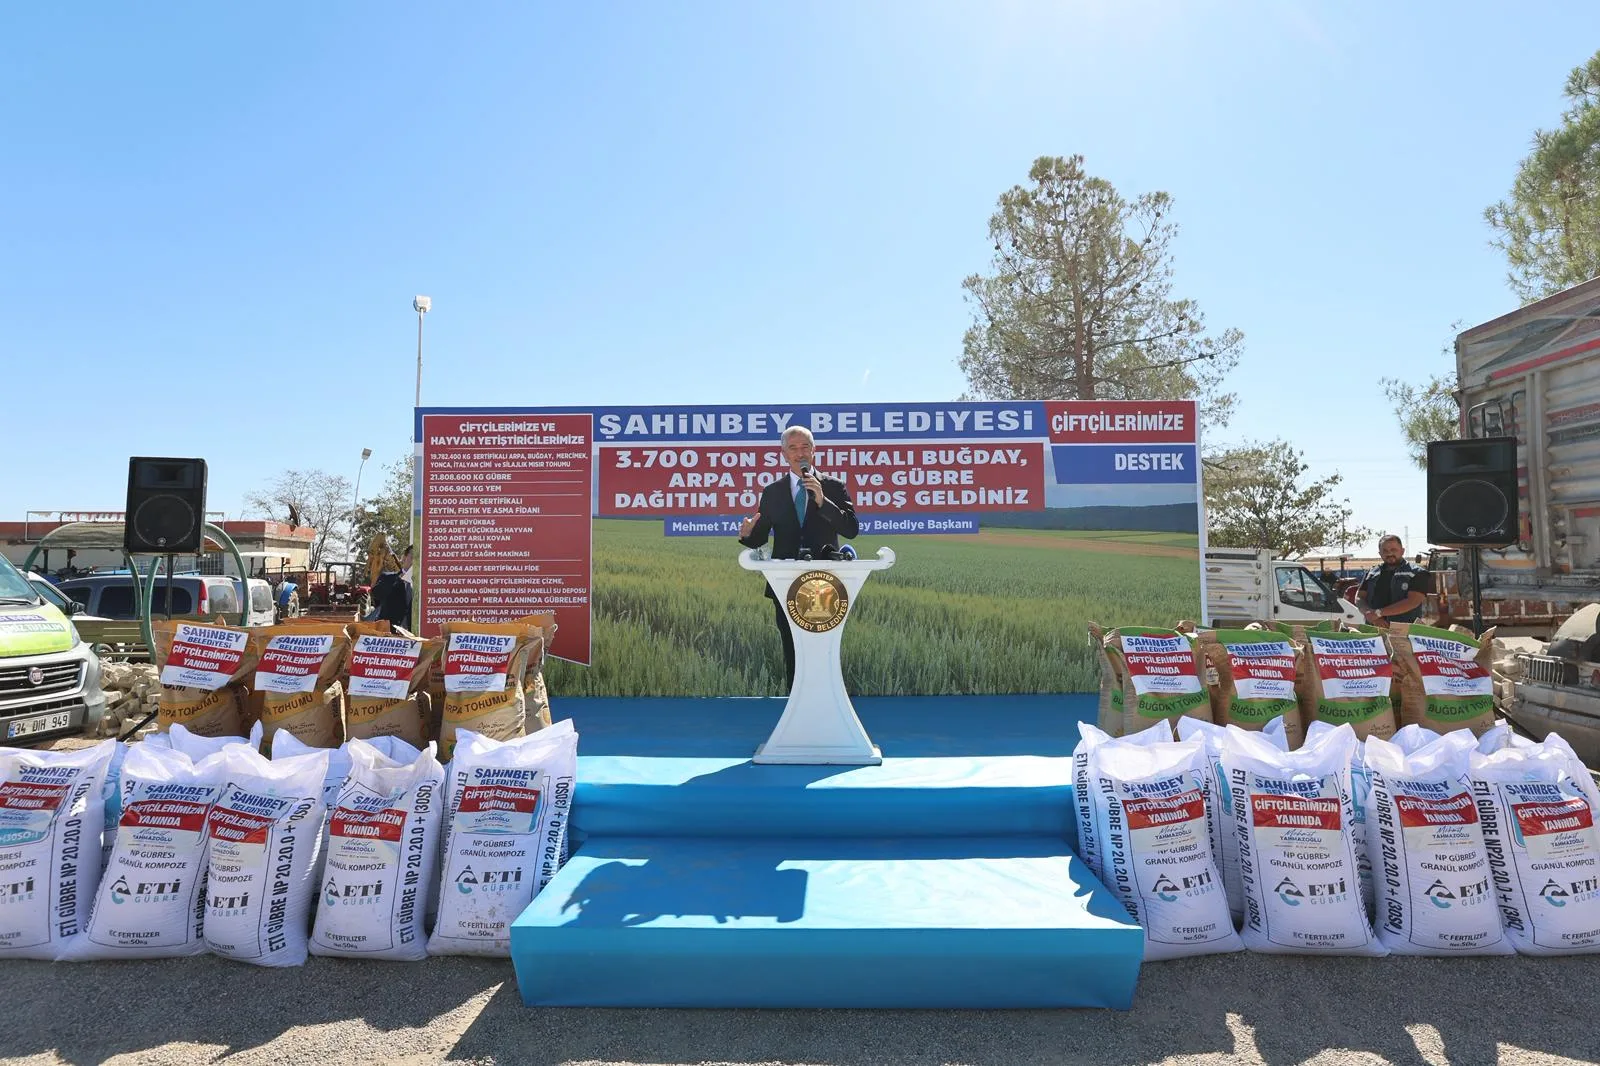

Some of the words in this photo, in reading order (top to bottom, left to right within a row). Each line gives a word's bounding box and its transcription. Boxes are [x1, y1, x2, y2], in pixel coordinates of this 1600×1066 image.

[460, 421, 540, 434] ÇİFTÇİLERİMİZE
[542, 422, 556, 432] VE
[1052, 412, 1184, 436] ÇİFTÇİLERİMİZE
[430, 436, 475, 445] HAYVAN
[479, 434, 584, 446] YETİŞTİRİCİLERİMİZE
[616, 450, 698, 468] 3.700
[706, 452, 756, 467] TON
[764, 448, 918, 467] SETİFİKALI
[923, 447, 1028, 466] BUĞDAY,
[1115, 452, 1184, 472] DESTEK
[668, 473, 734, 487] ARPA
[855, 474, 883, 486] ve
[892, 468, 974, 486] GÜBRE
[615, 490, 720, 508] DAĞITIM
[857, 491, 906, 508] HOŞ
[915, 487, 1028, 506] GELDİNİZ
[672, 521, 718, 532] Mehmet
[874, 519, 924, 531] Belediye
[927, 518, 972, 532] Başkanı
[183, 657, 220, 671] YANINDA
[276, 664, 309, 675] YANINDA
[1145, 665, 1180, 674] YANINDA
[364, 667, 397, 678] YANINDA
[1249, 668, 1284, 679] YANINDA
[464, 694, 508, 713] TOHUMU
[15, 723, 26, 735] 34
[52, 715, 68, 728] 949
[138, 815, 181, 826] YANINDA
[1148, 809, 1189, 824] YANINDA
[1276, 814, 1322, 826] YANINDA
[1541, 816, 1581, 831] YANINDA
[343, 824, 380, 836] YANINDA
[61, 819, 81, 861] 20.20.0
[408, 827, 425, 868] 20.20.0
[275, 835, 295, 880] 20.20.0
[60, 862, 77, 878] NP
[348, 862, 387, 872] KOMPOZE
[404, 871, 419, 888] NP
[272, 880, 289, 896] NP
[55, 879, 77, 917] GÜBRE
